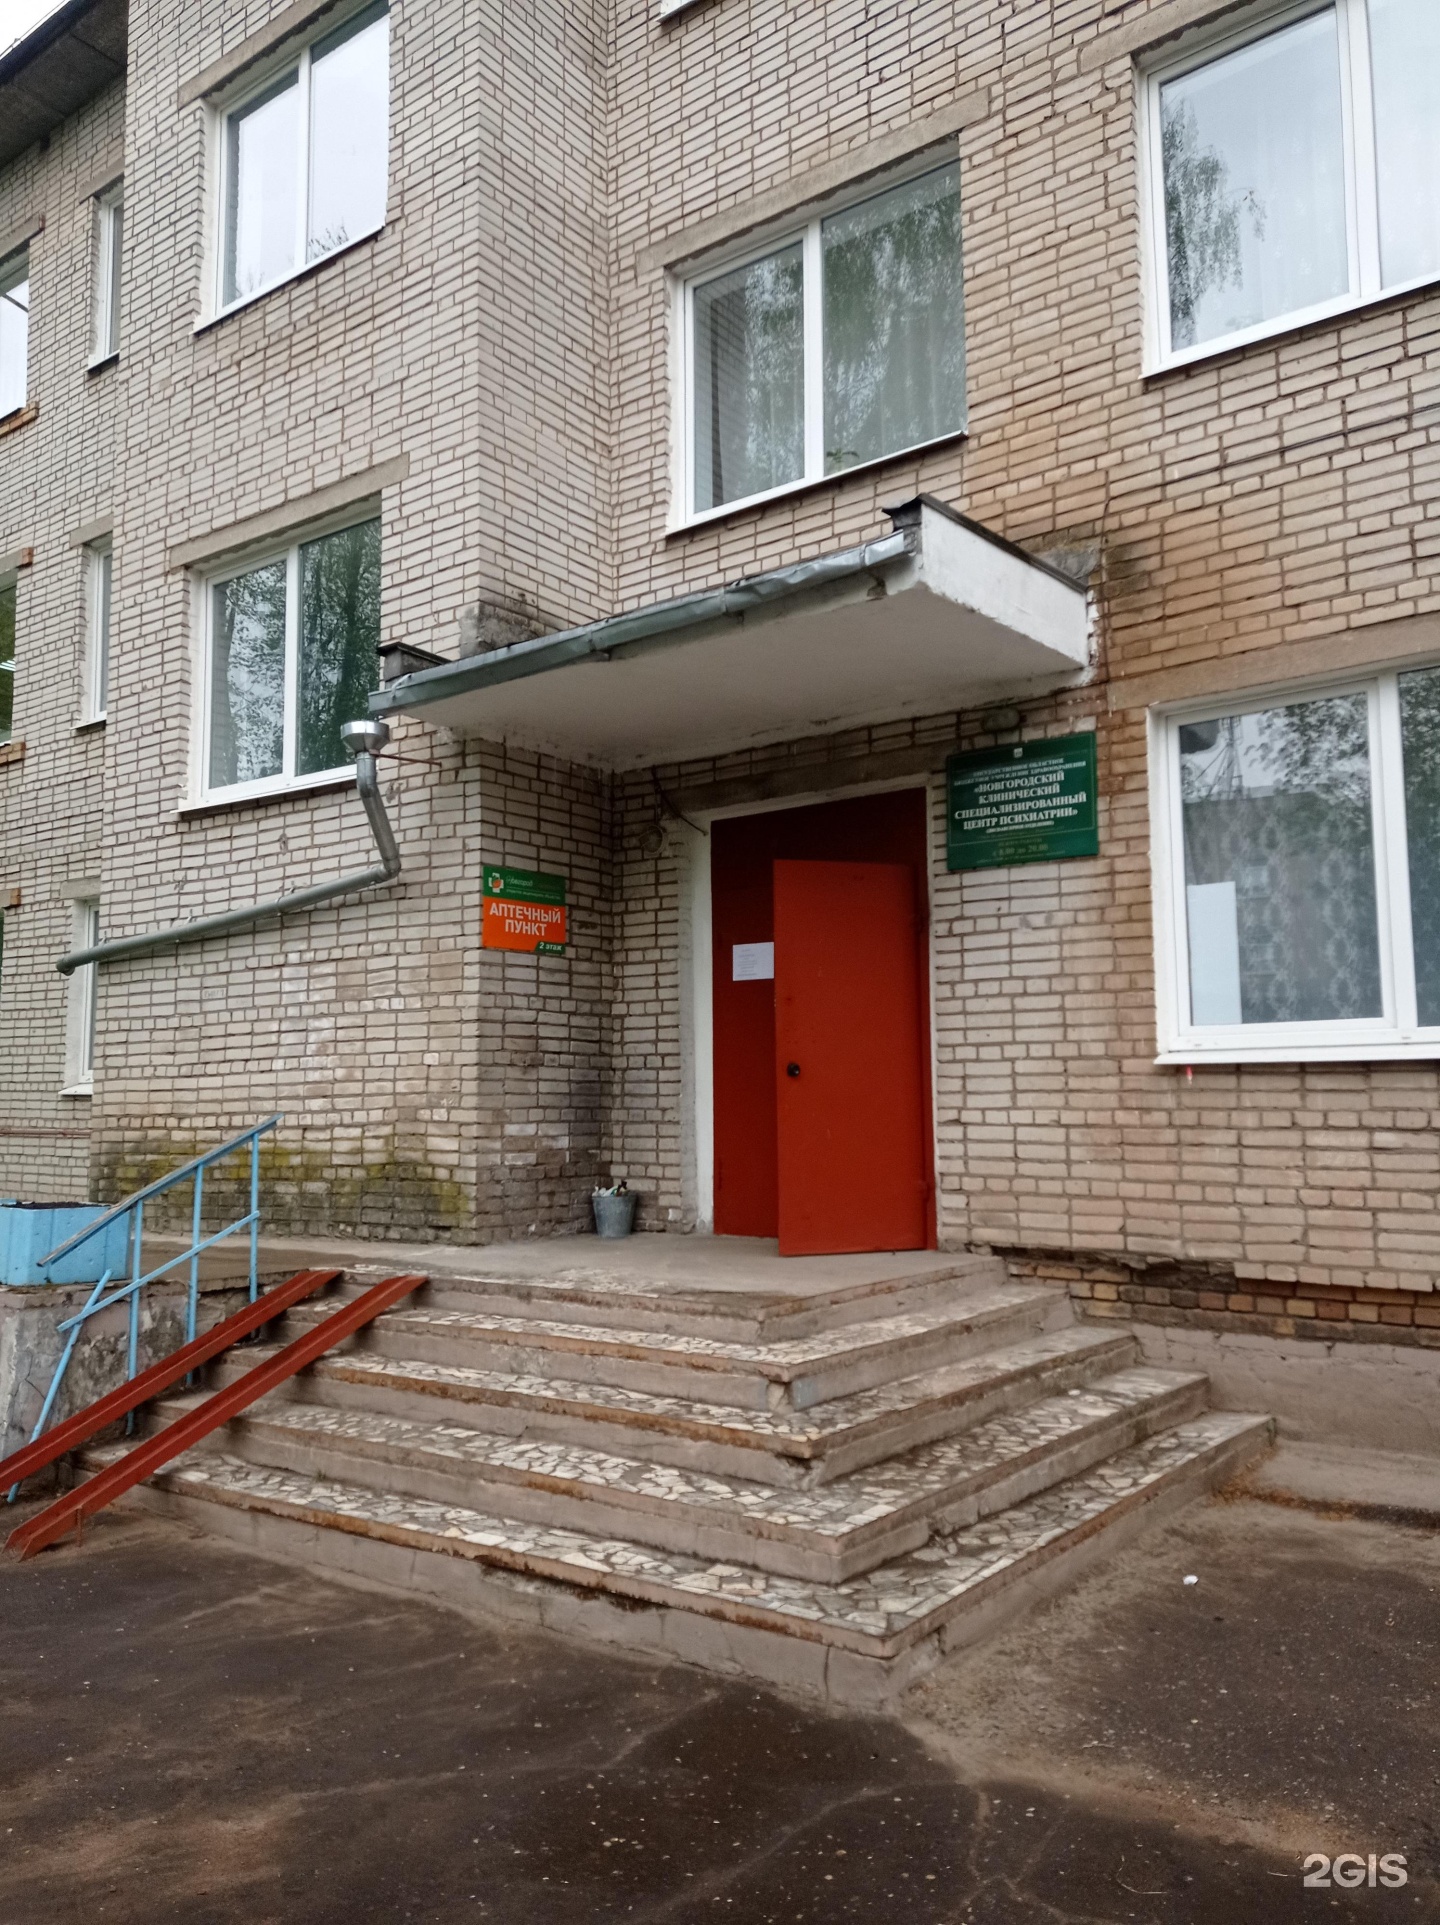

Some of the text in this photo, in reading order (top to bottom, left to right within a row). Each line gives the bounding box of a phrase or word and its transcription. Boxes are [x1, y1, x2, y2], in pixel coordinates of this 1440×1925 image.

[974, 770, 1065, 793] «НОВГОРОДСКИЙ
[978, 782, 1060, 804] КЛИНИЧЕСКИЙ
[954, 791, 1087, 819] СПЕЦИАЛИЗИРОВАННЫЙ
[963, 807, 1078, 830] ЦЕНТР ПСИХИАТРИИ»
[489, 902, 561, 923] АПТЕЧНЫЙ
[505, 919, 547, 936] ПУНКТ
[539, 941, 545, 949] 2
